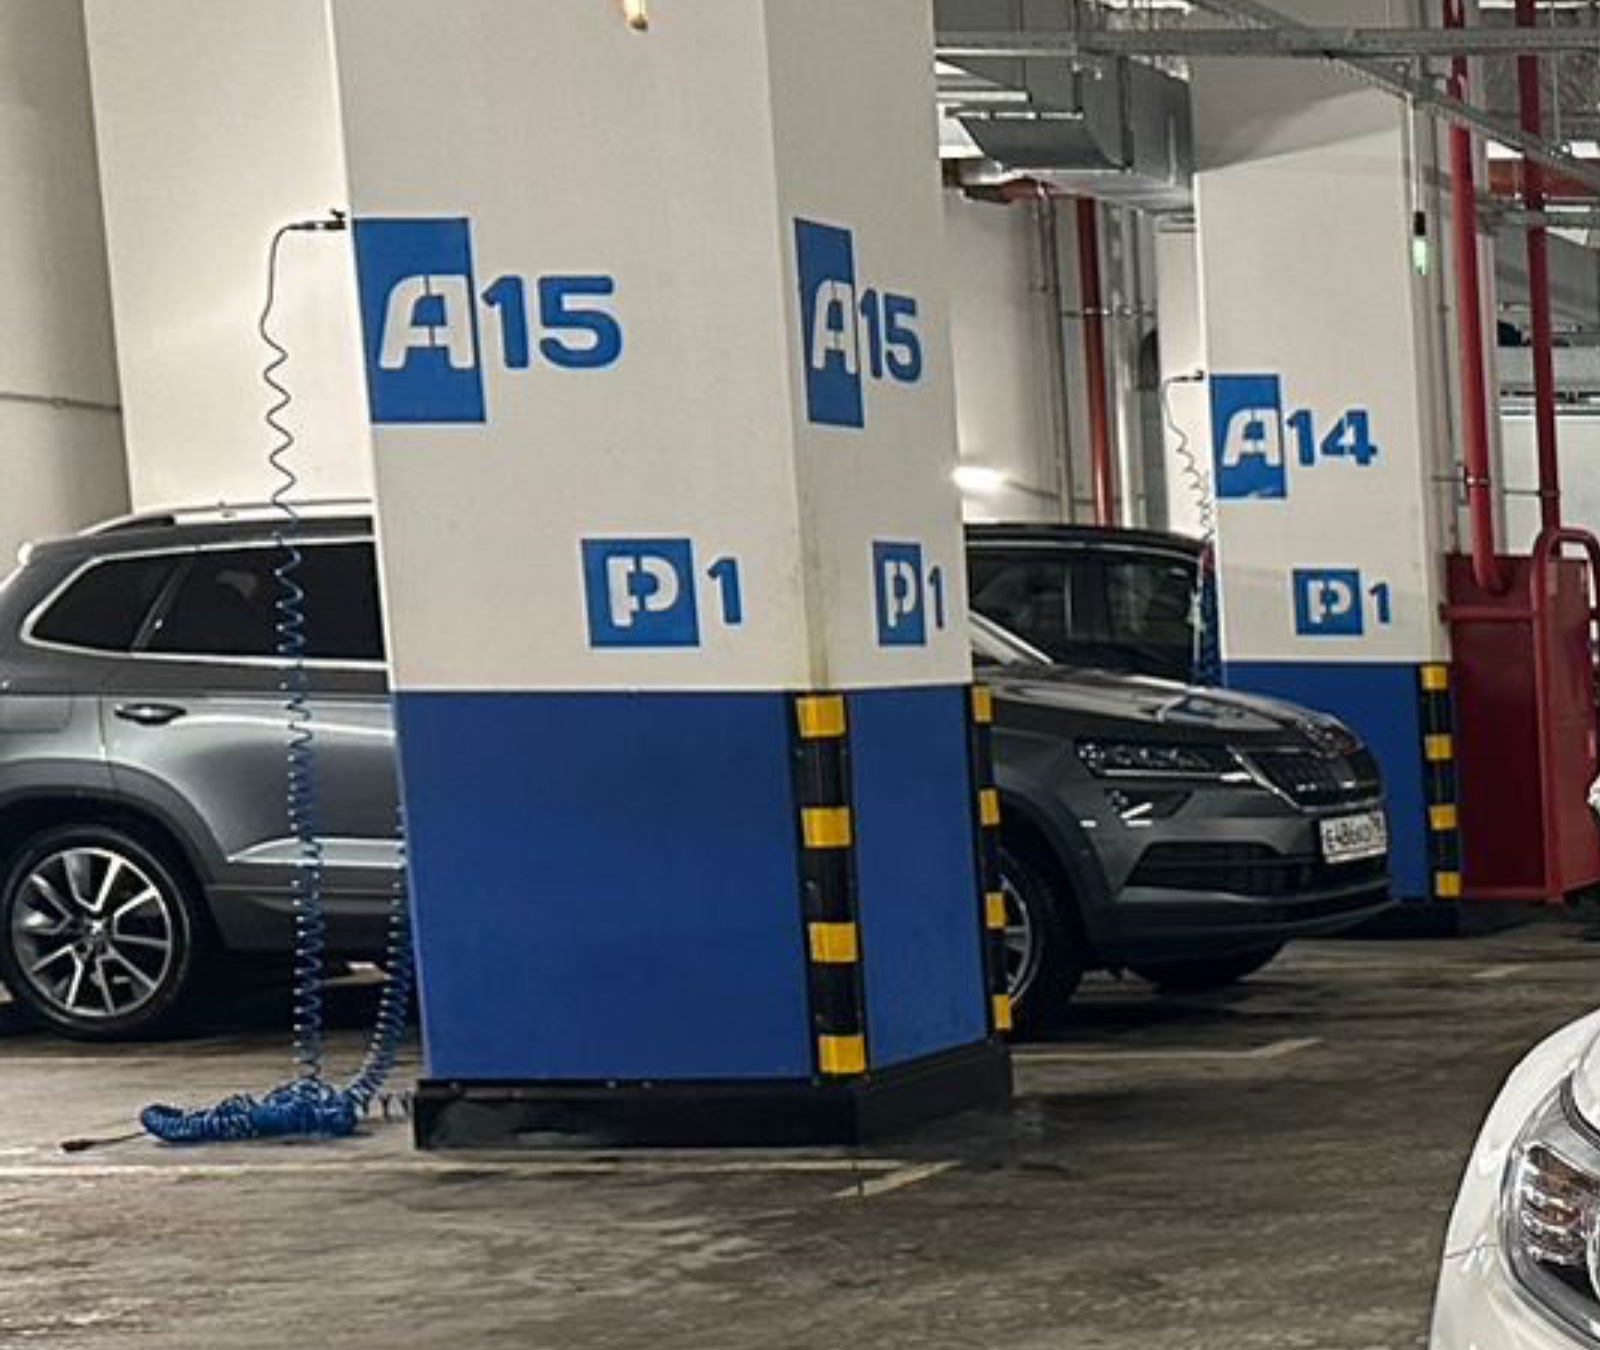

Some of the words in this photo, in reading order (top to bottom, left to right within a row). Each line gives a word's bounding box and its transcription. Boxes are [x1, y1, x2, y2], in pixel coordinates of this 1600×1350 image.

[379, 275, 621, 370] A15
[810, 277, 922, 382] A15
[1222, 409, 1377, 465] A14
